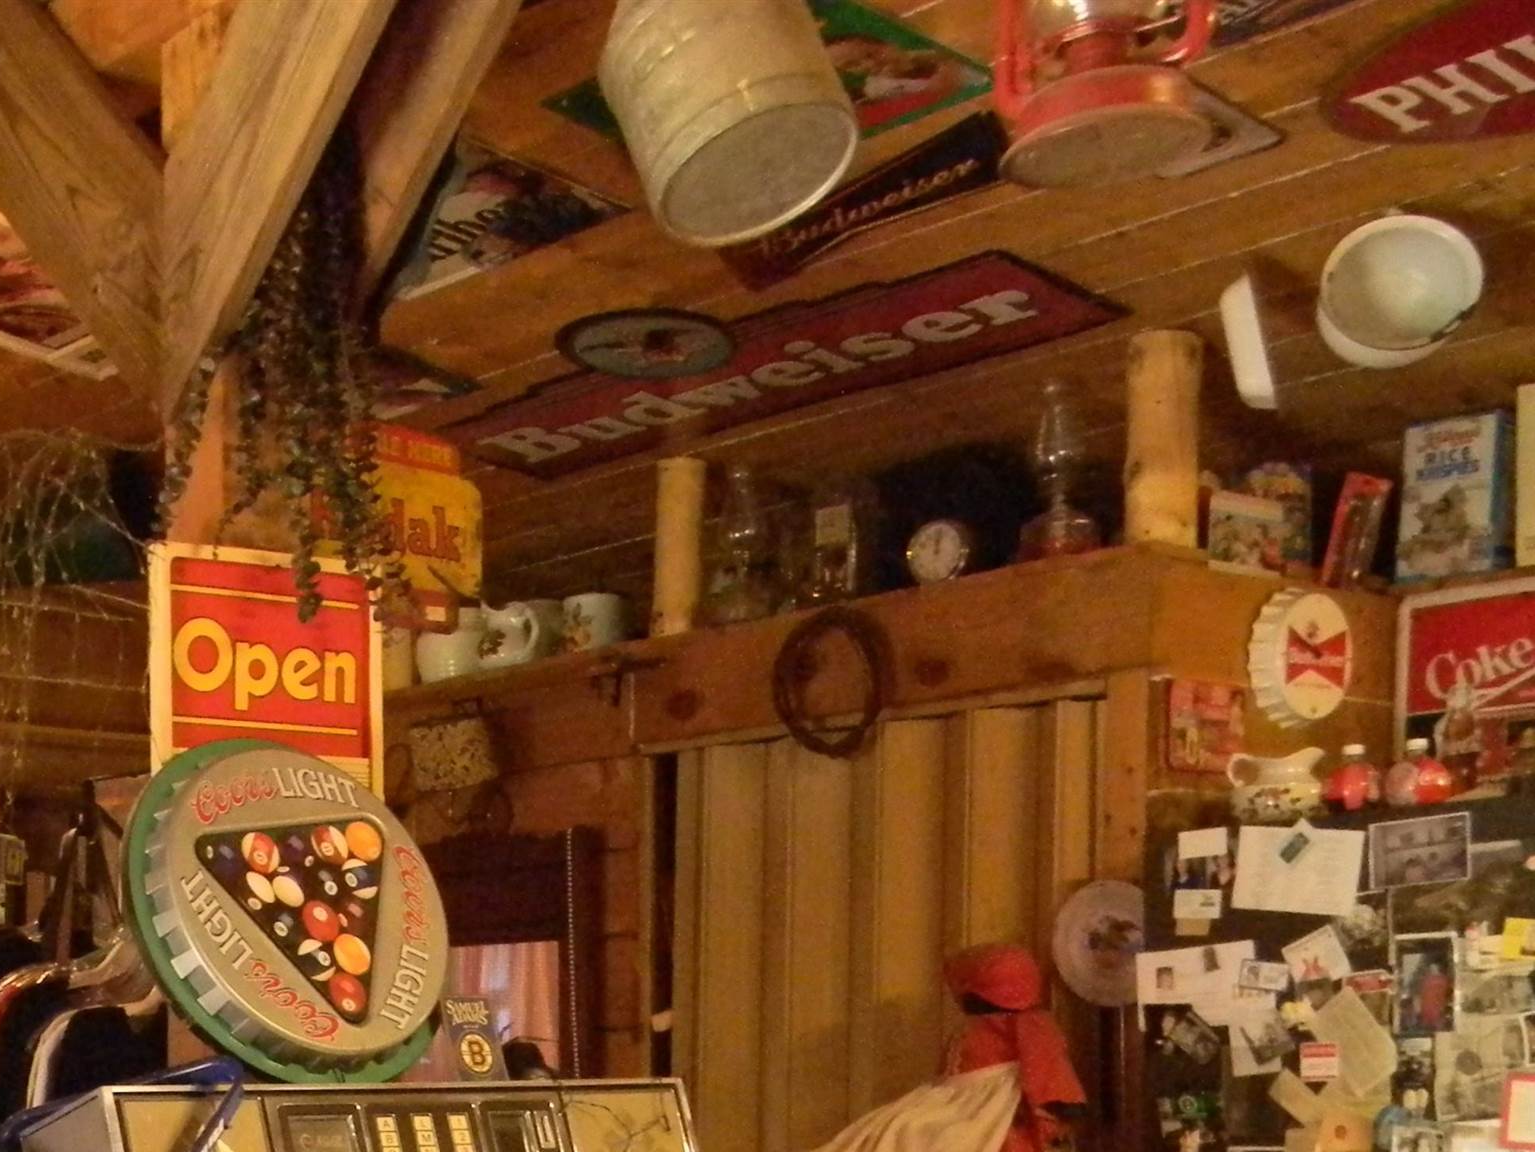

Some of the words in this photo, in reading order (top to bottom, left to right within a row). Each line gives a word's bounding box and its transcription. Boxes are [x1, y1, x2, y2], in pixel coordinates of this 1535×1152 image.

[1348, 34, 1535, 134] PHI
[476, 287, 1039, 464] Budweiser
[173, 616, 357, 711] Open
[1425, 637, 1535, 700] Coke
[191, 774, 276, 825] Coors
[271, 766, 361, 808] LIGHT
[180, 870, 255, 971] LIGHT
[392, 845, 431, 947] Coors
[243, 958, 343, 1043] Coors
[379, 943, 430, 1031] LIGHT
[467, 1040, 486, 1066] B
